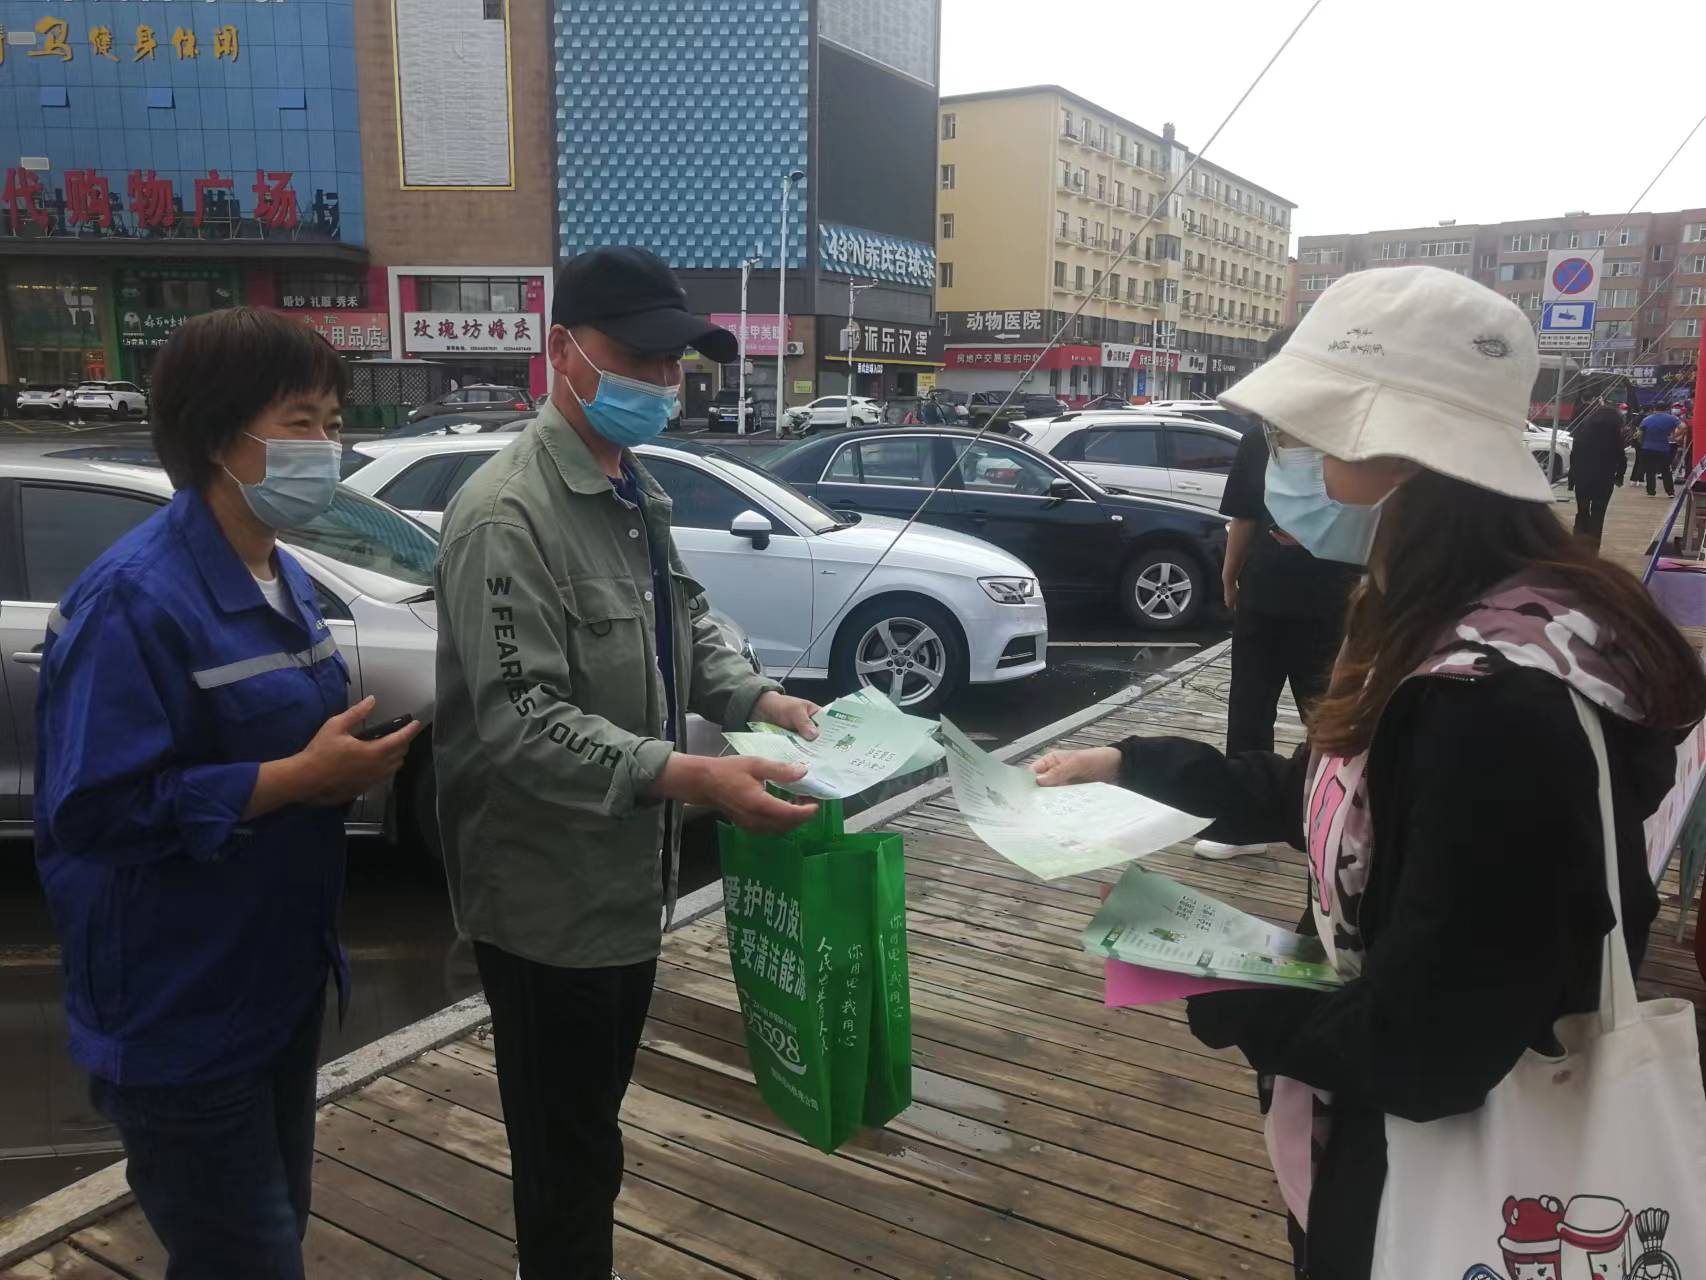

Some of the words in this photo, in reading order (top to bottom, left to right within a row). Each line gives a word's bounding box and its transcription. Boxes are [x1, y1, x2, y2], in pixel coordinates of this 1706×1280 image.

[2, 167, 298, 230] 代购物广场
[413, 317, 531, 341] 玫瑰坊婚庆
[966, 310, 1041, 331] 动物医院
[865, 326, 928, 355] 派乐汉堡
